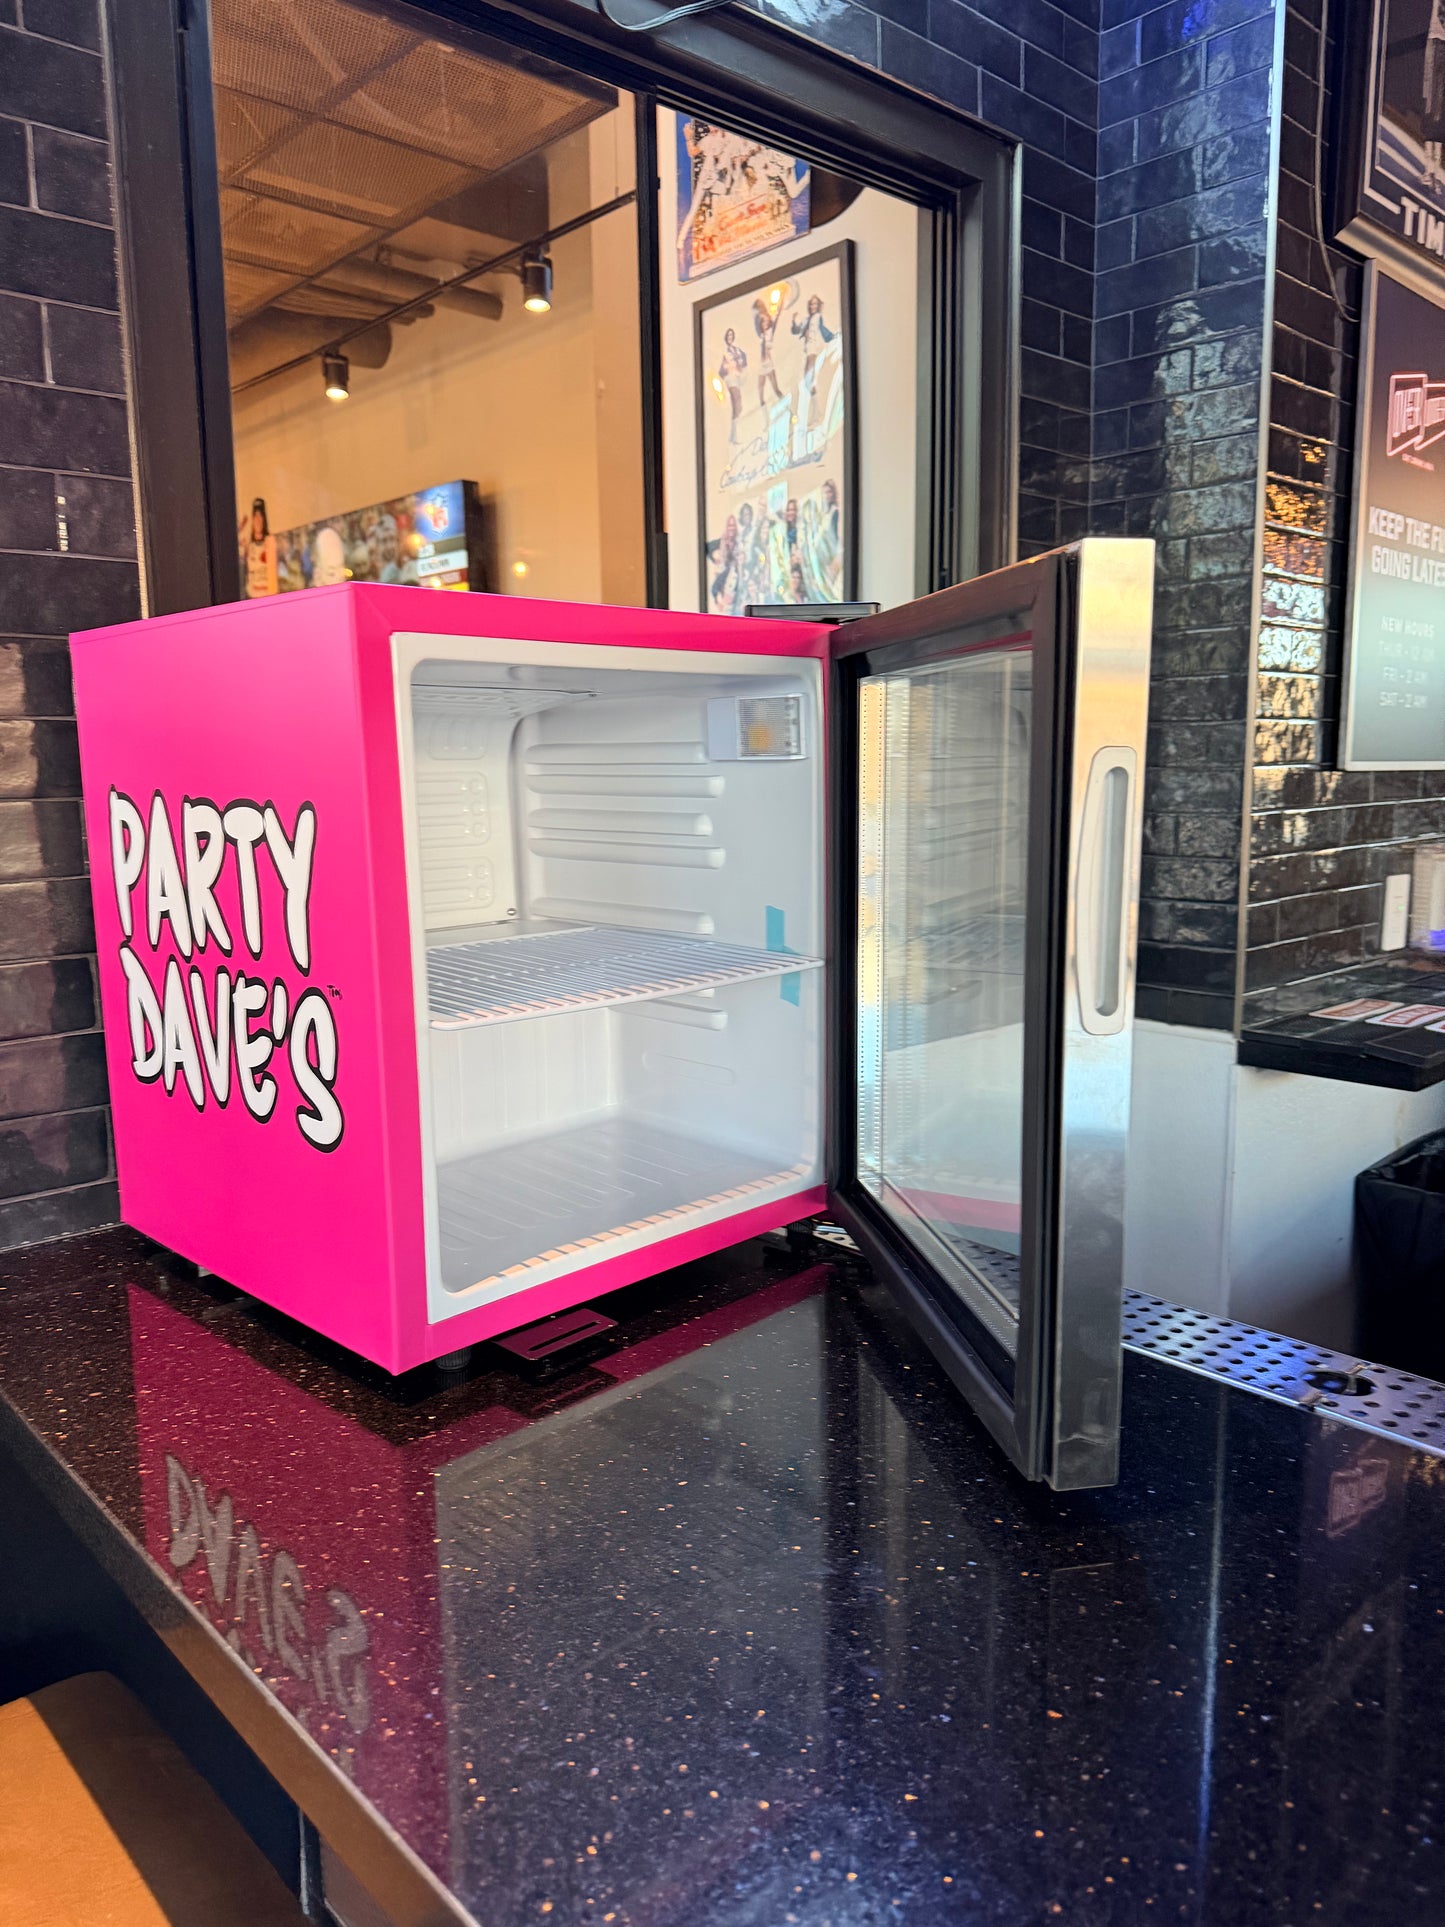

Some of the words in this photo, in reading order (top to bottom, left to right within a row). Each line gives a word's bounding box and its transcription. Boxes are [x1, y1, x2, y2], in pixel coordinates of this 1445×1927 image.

[1368, 506, 1405, 540] KEEP
[1405, 517, 1431, 549] THE
[1371, 545, 1411, 580] GOING
[1381, 616, 1403, 633] NEW
[109, 784, 317, 977] PARTY
[119, 940, 344, 1153] DAVE'S
